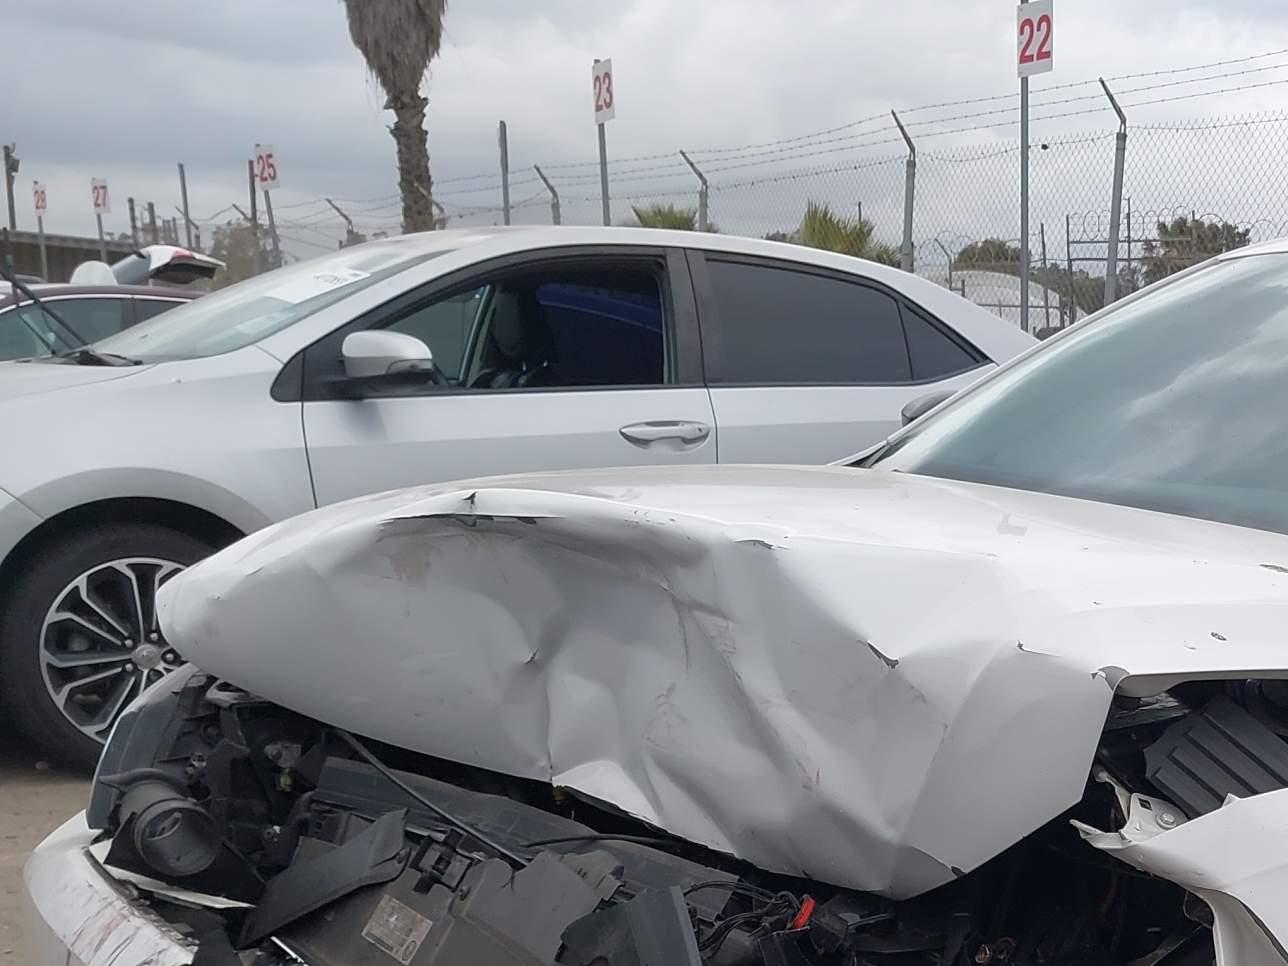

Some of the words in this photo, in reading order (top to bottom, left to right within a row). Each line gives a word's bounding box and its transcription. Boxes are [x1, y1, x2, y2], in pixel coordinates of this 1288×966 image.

[1019, 15, 1052, 66] 22
[593, 71, 614, 113] 23
[257, 154, 277, 182] 25
[92, 185, 108, 208] 27
